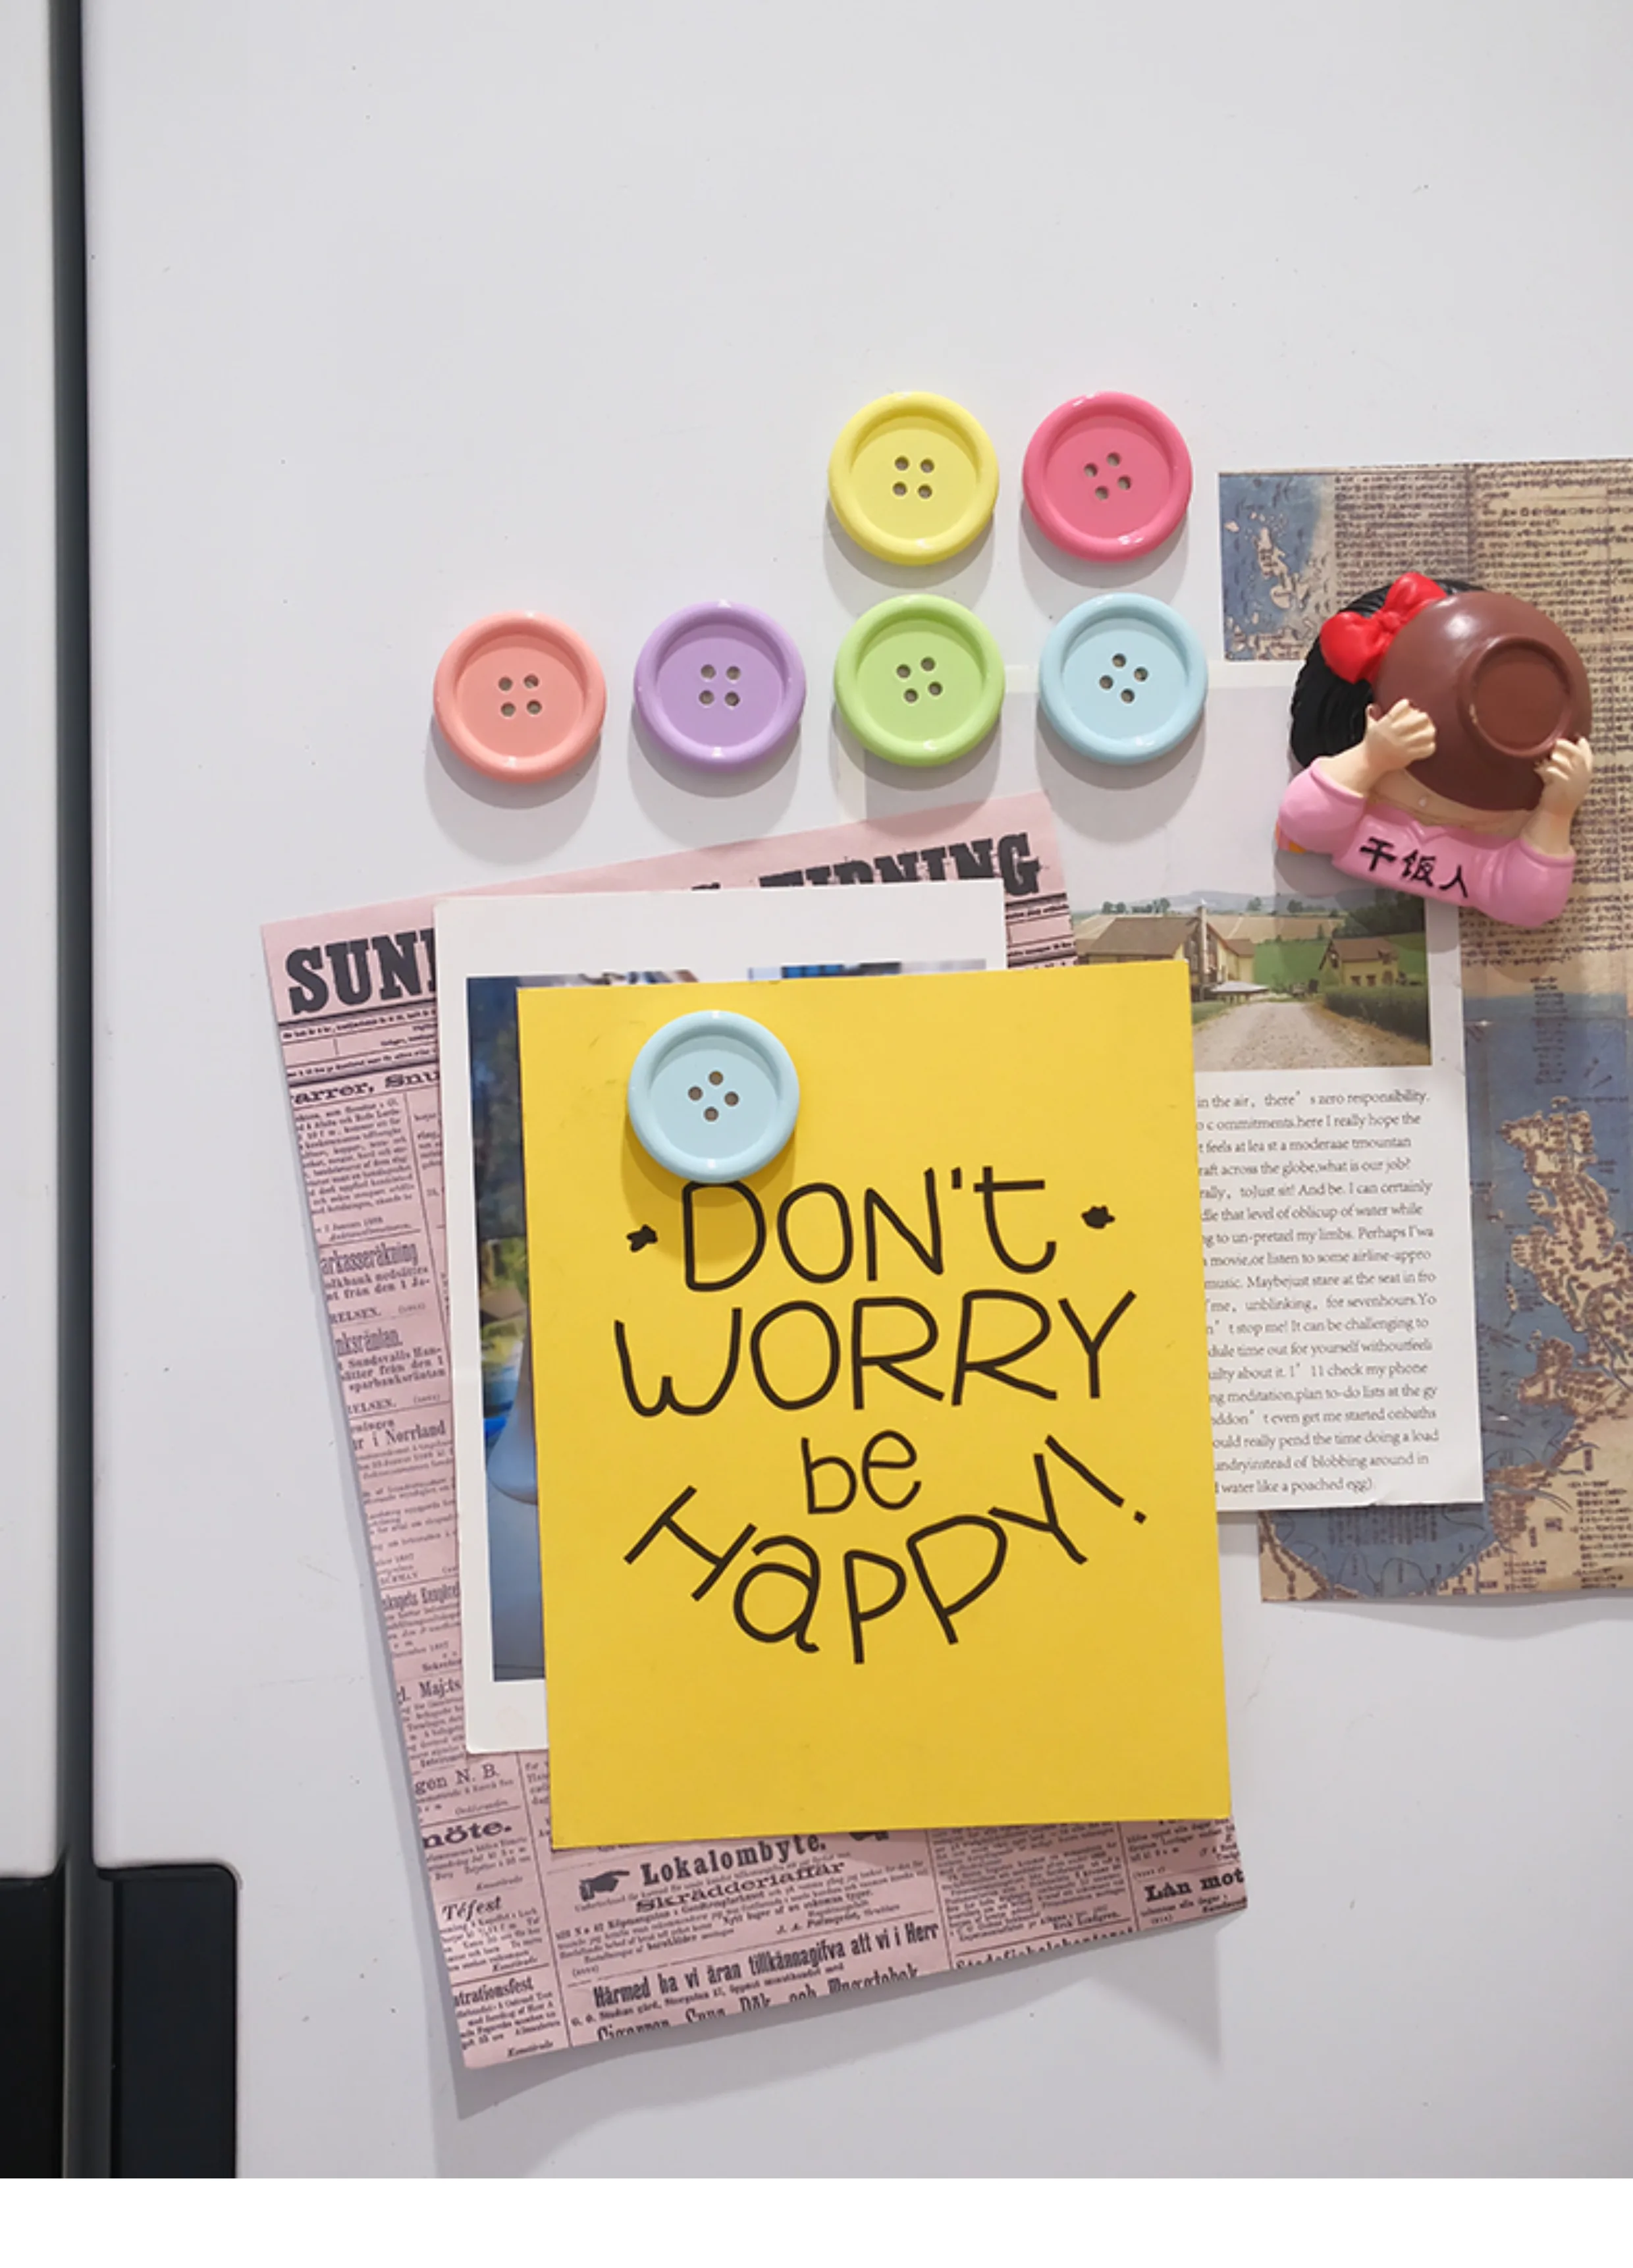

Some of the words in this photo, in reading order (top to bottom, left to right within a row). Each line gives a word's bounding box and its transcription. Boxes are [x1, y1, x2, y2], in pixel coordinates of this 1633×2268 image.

[1360, 836, 1469, 899] 干饭人
[1211, 1094, 1231, 1108] the
[1333, 1113, 1366, 1129] really
[1368, 1112, 1400, 1129] hope
[1401, 1111, 1421, 1125] the
[1206, 1139, 1233, 1154] feels
[1234, 1141, 1246, 1153] at
[1221, 1165, 1259, 1176] across
[1260, 1161, 1281, 1175] the
[1349, 1162, 1360, 1172] is
[1360, 1161, 1383, 1172] our
[1385, 1156, 1412, 1174] job?
[1297, 1182, 1326, 1197] And
[1356, 1184, 1379, 1195] can
[1379, 1179, 1433, 1196] certainly
[1221, 1207, 1245, 1222] that
[1246, 1206, 1275, 1220] level
[1275, 1205, 1291, 1220] of
[1340, 1202, 1355, 1218] of
[1354, 1206, 1389, 1217] water
[1391, 1202, 1423, 1216] while
[682, 1166, 1056, 1292] DON't
[1216, 1233, 1231, 1245] to
[1296, 1231, 1318, 1245] my
[1358, 1226, 1406, 1242] Perhaps
[1266, 1251, 1300, 1265] listen
[1301, 1253, 1316, 1264] to
[1317, 1253, 1350, 1264] some
[1312, 1276, 1340, 1286] stare
[1342, 1274, 1354, 1286] at
[1356, 1272, 1376, 1285] the
[1378, 1273, 1401, 1284] seat
[1403, 1273, 1416, 1283] in
[1325, 1294, 1345, 1309] for
[1236, 1324, 1264, 1337] stop
[1264, 1320, 1288, 1334] me!
[1291, 1320, 1300, 1333] It
[1302, 1322, 1325, 1332] can
[1326, 1318, 1343, 1332] be
[1343, 1316, 1414, 1334] challenging
[1415, 1318, 1430, 1329] to
[614, 1288, 1137, 1417] WORRY
[1237, 1346, 1265, 1357] time
[1266, 1345, 1288, 1356] out
[1290, 1341, 1308, 1355] for
[1310, 1339, 1360, 1357] yourself
[1237, 1366, 1272, 1380] about
[1326, 1363, 1364, 1377] check
[1365, 1365, 1387, 1379] my
[1388, 1361, 1428, 1378] phone
[1325, 1385, 1361, 1399] to-do
[1362, 1385, 1385, 1399] lists
[1387, 1387, 1399, 1397] at
[1401, 1383, 1420, 1397] the
[1423, 1386, 1438, 1401] gy
[1270, 1413, 1300, 1425] even
[1301, 1412, 1320, 1428] get
[1323, 1413, 1343, 1422] me
[1345, 1407, 1385, 1421] started
[385, 1418, 447, 1446] Norrland
[1243, 1434, 1276, 1451] really
[1278, 1432, 1311, 1451] pend
[1312, 1432, 1333, 1445] the
[1334, 1434, 1362, 1445] time
[1363, 1430, 1401, 1447] doing
[1411, 1428, 1439, 1442] load
[1293, 1455, 1309, 1469] of
[1311, 1454, 1368, 1471] blobbing
[1369, 1451, 1414, 1467] around
[1417, 1455, 1429, 1465] in
[801, 1428, 922, 1516] be
[1221, 1483, 1255, 1494] water
[1256, 1479, 1279, 1493] like
[1291, 1476, 1344, 1496] poached
[640, 1833, 827, 1886] Lokalombyte.
[1199, 1866, 1245, 1891] mot
[593, 1975, 652, 2009] Härmed
[684, 1966, 700, 1989] vi
[851, 1928, 872, 1955] att
[874, 1928, 890, 1950] vi
[904, 1920, 940, 1945] Herr
